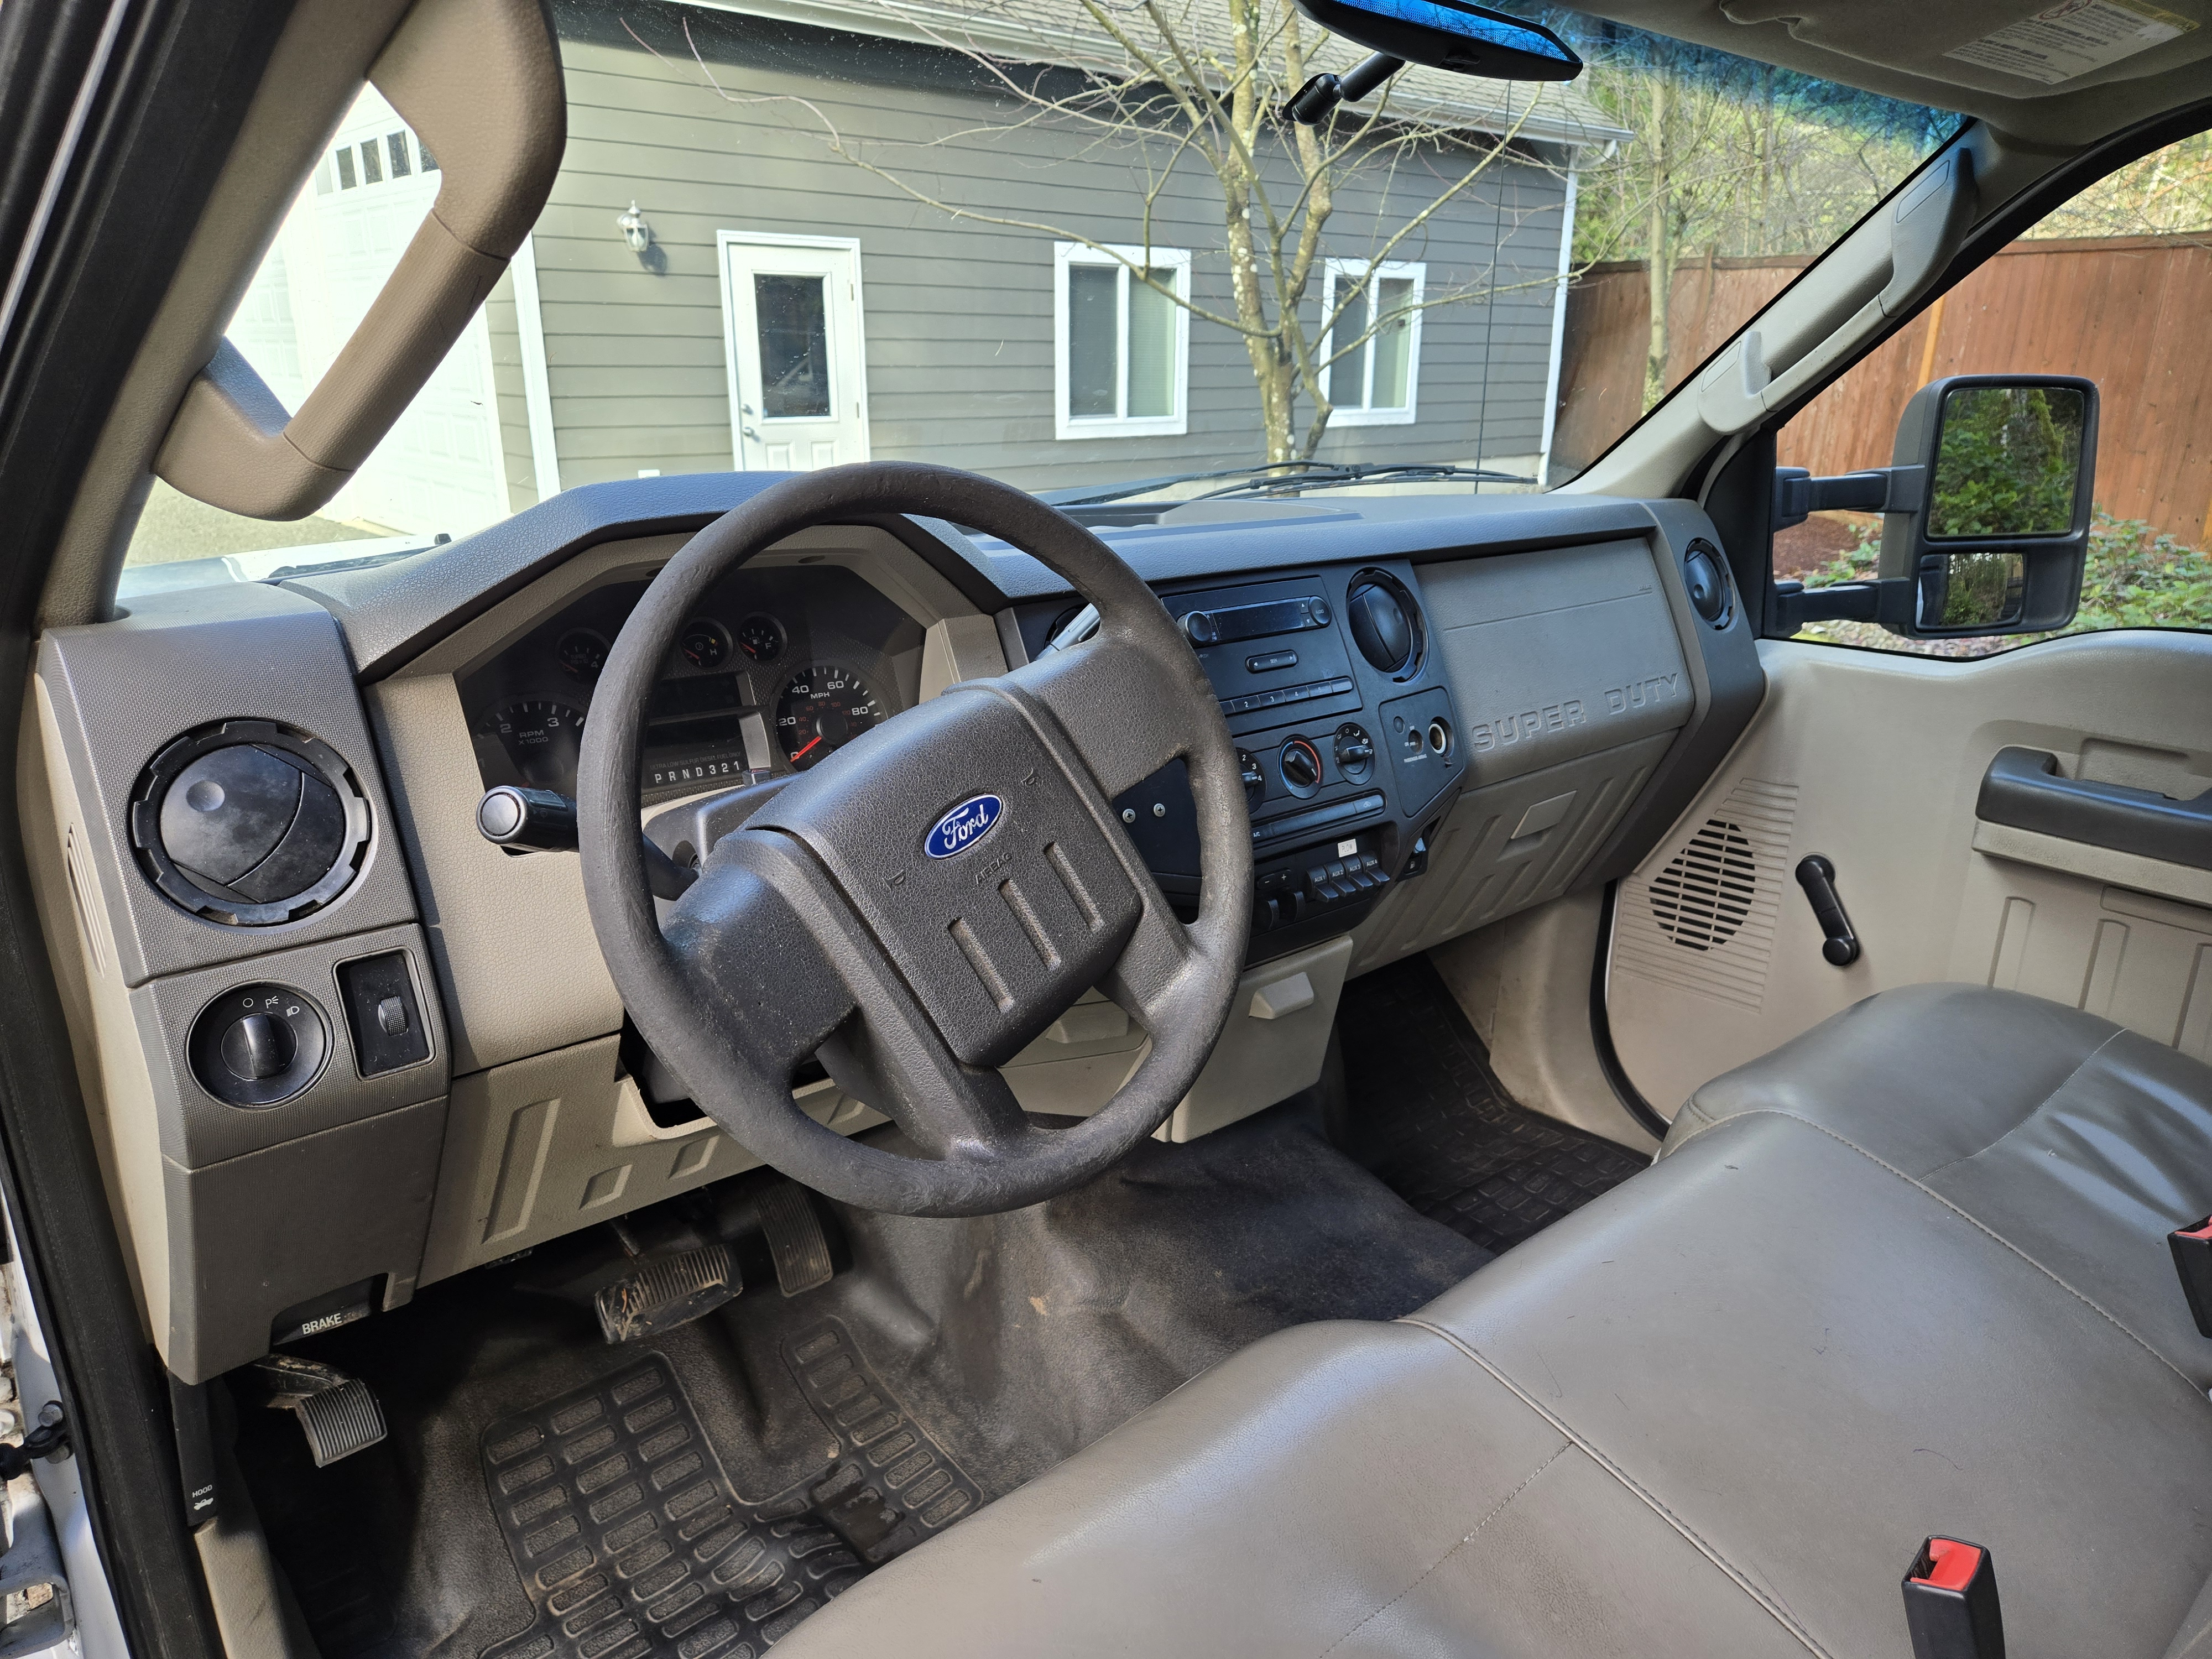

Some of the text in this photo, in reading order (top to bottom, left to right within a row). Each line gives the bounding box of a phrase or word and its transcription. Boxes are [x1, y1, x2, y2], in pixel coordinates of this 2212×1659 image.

[791, 685, 809, 694] 40
[827, 681, 844, 690] 60
[852, 706, 868, 716] 80
[1472, 672, 1678, 753] SUPER DUTY
[547, 717, 560, 727] 3
[779, 717, 796, 726] 20
[499, 723, 513, 733] 2
[519, 729, 544, 738] RPM
[655, 761, 739, 784] P R N D 3 2 1
[942, 804, 989, 849] Ford
[1342, 843, 1353, 852] PLOW
[975, 852, 1013, 885] AIRBAG
[301, 1313, 342, 1335] BRAKE
[192, 1484, 213, 1498] HOOD
